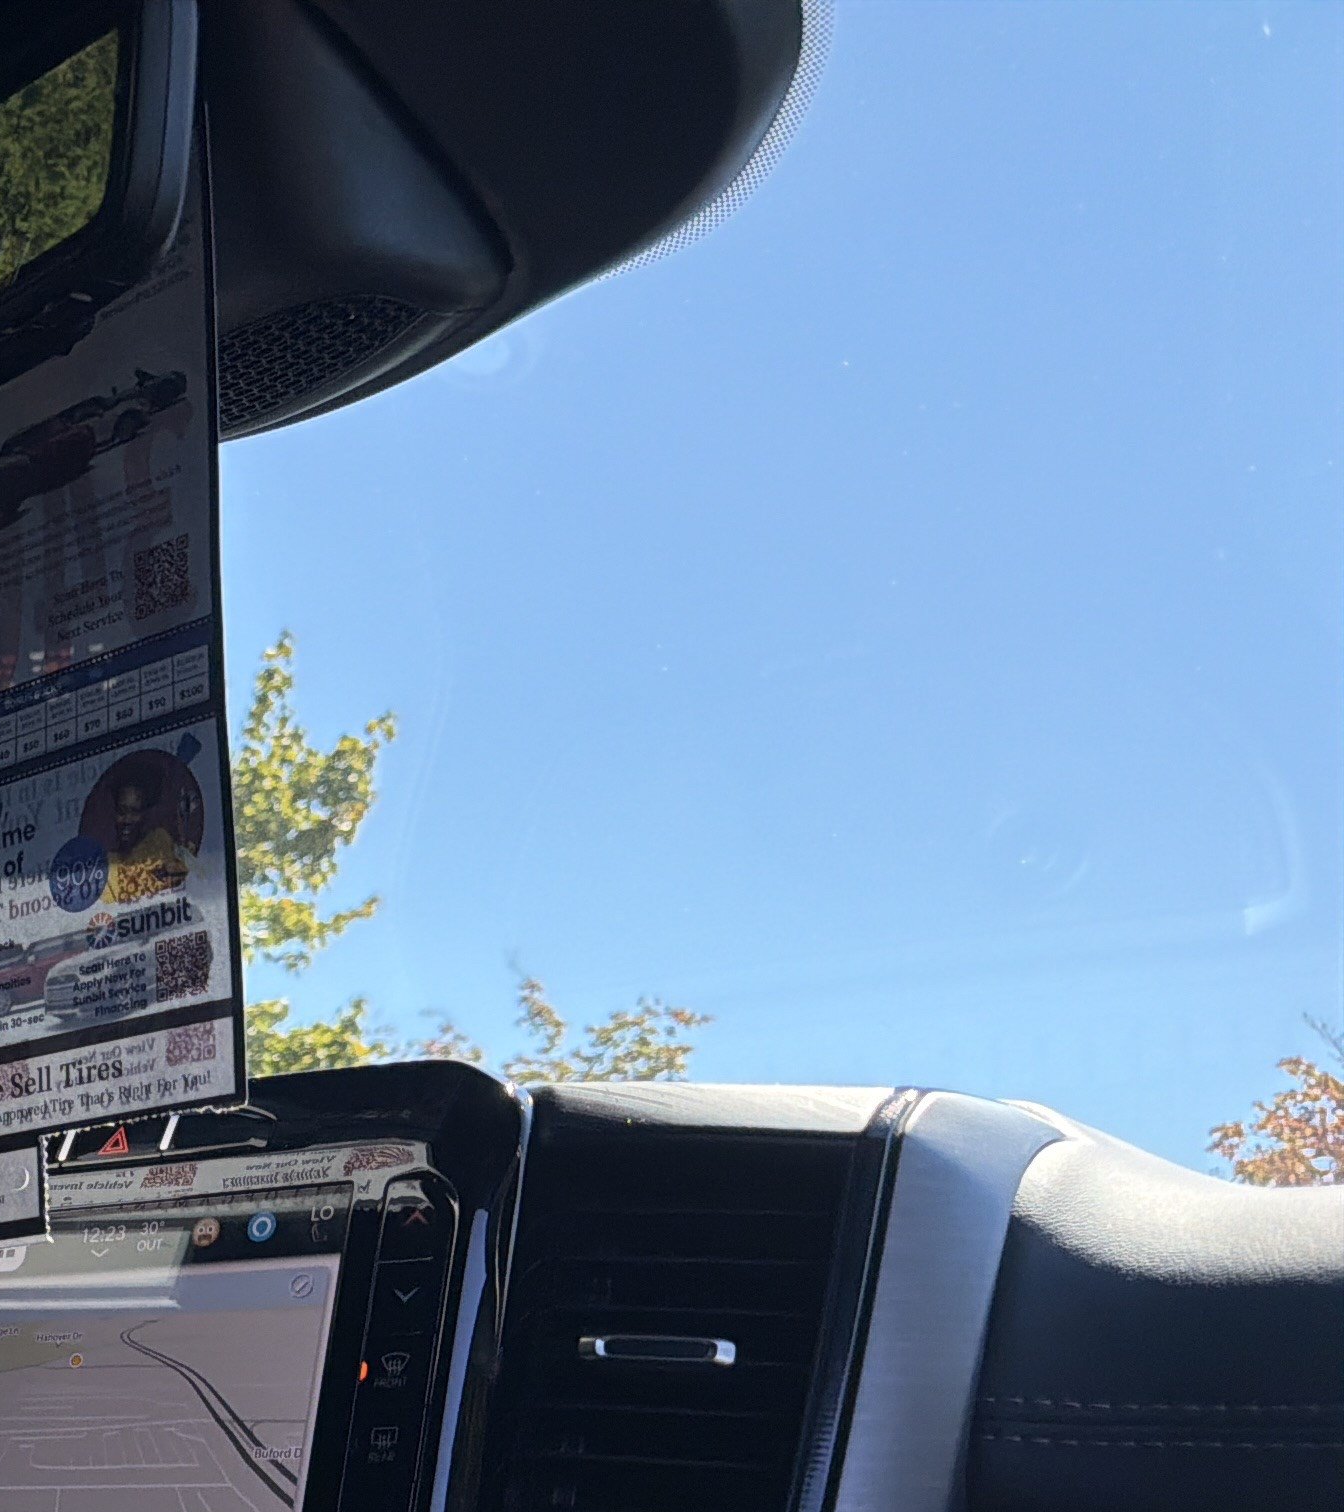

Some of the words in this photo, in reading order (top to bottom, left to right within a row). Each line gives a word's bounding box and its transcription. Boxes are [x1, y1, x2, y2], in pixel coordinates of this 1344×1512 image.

[4, 851, 24, 875] of
[57, 856, 103, 886] 90%
[117, 896, 191, 938] sunbit
[72, 976, 101, 994] Apply
[129, 965, 145, 978] For
[94, 995, 147, 1021] Financing
[0, 1019, 8, 1030] in
[10, 1011, 44, 1028] 30-sec
[8, 1065, 52, 1098] Sell
[59, 1051, 123, 1088] Tires
[312, 1205, 334, 1220] LO
[83, 1224, 126, 1243] 12:23
[140, 1221, 165, 1236] 30°
[137, 1238, 163, 1252] OUT
[254, 1447, 291, 1459] Buford
